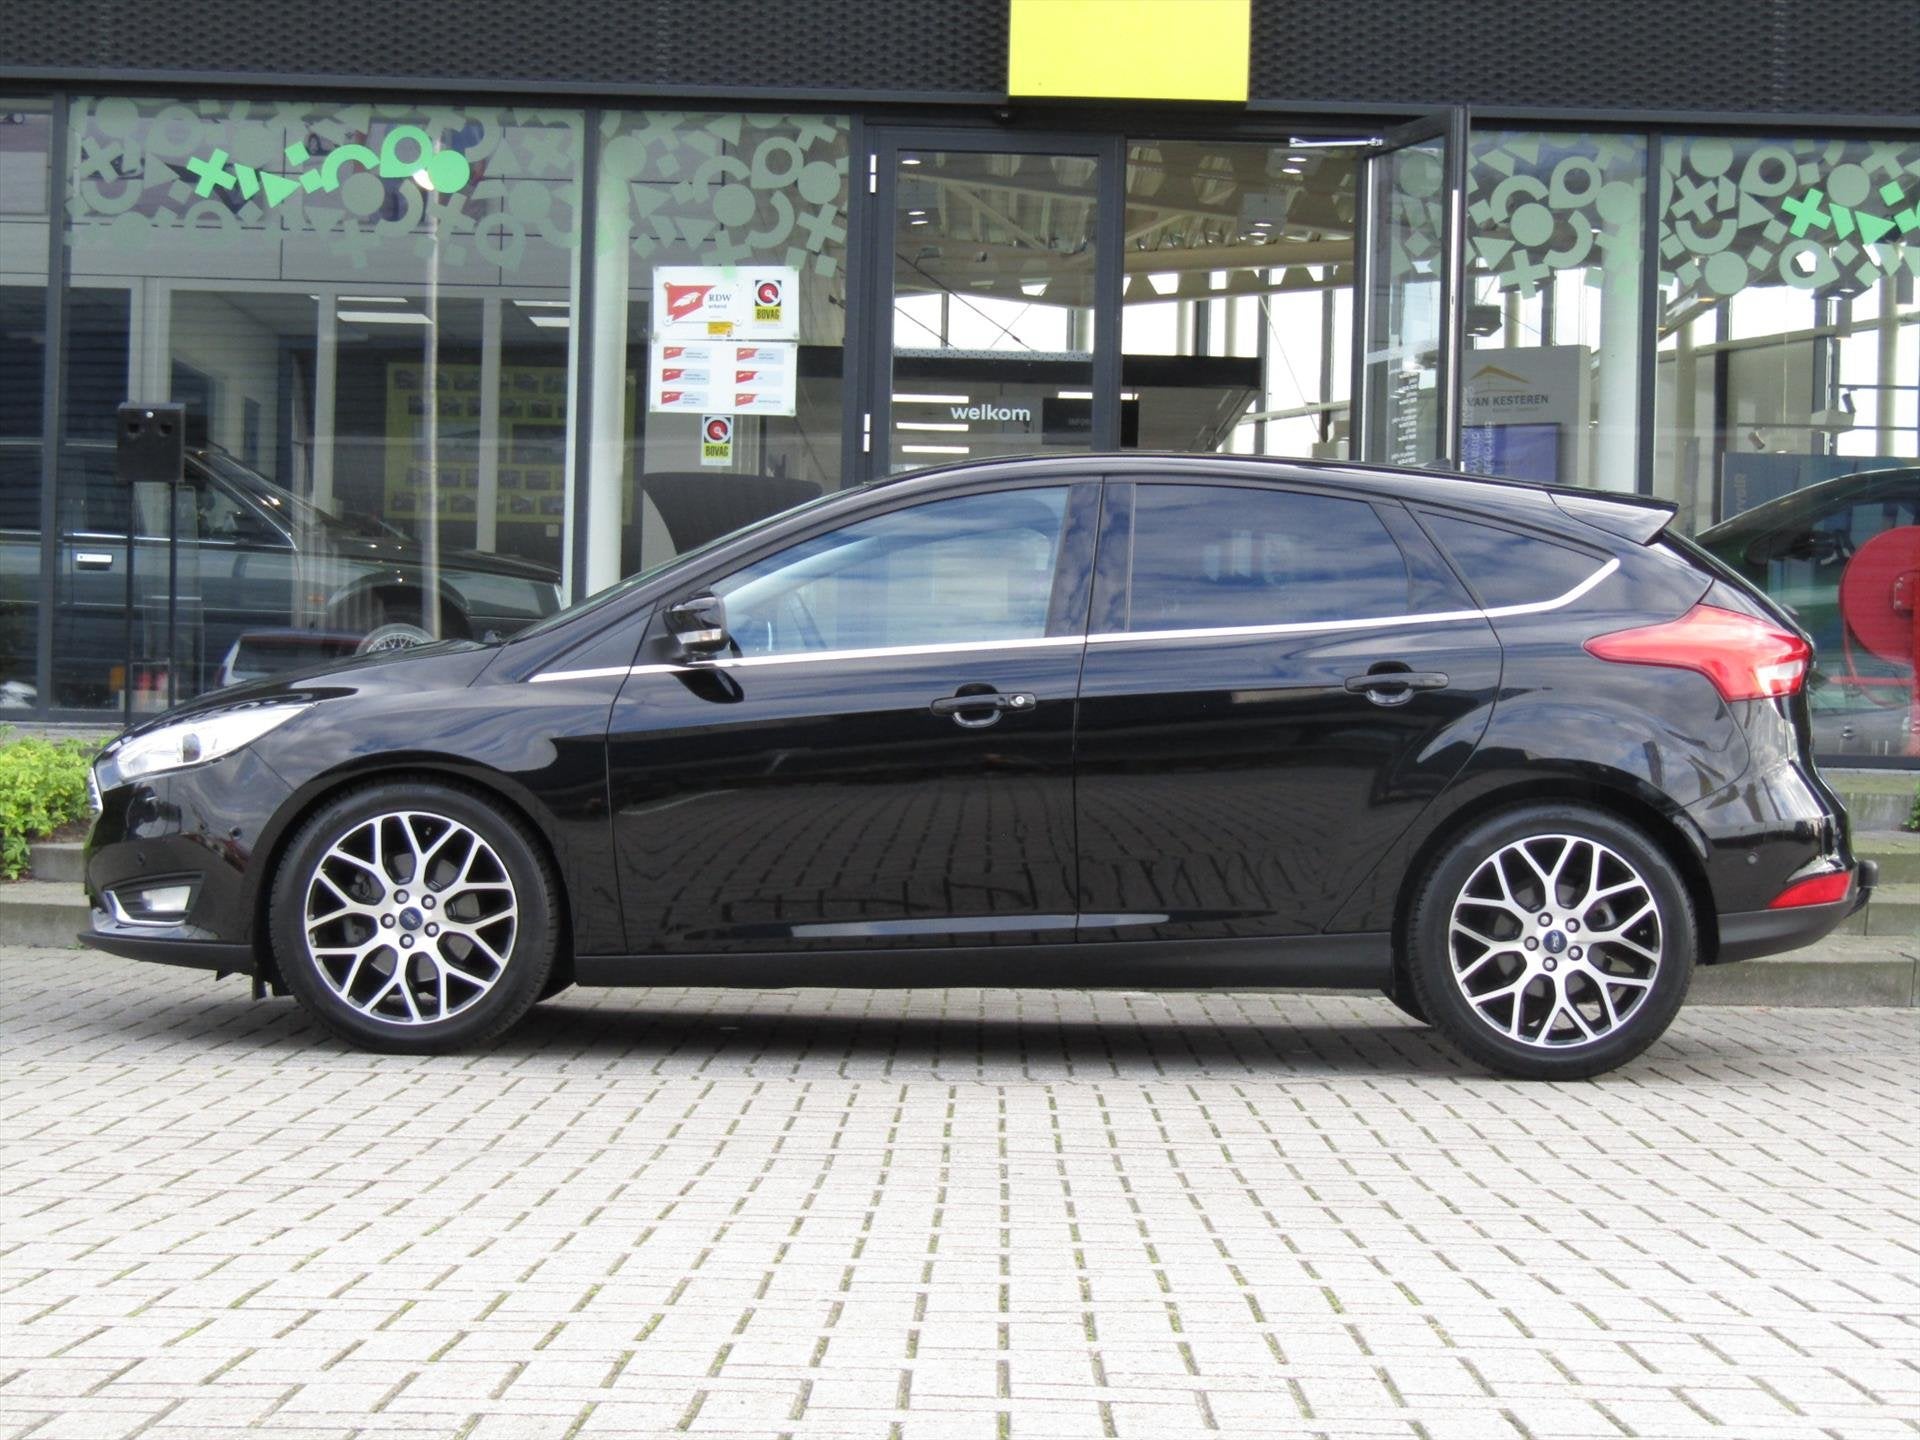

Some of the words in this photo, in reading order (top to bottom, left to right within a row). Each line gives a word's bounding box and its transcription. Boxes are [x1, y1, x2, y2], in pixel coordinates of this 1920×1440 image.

[708, 293, 732, 302] RDW
[756, 309, 780, 320] BOVAG
[1467, 397, 1489, 407] VAN
[1492, 394, 1549, 406] KESTEREN
[950, 404, 1031, 421] welkom
[705, 445, 729, 457] BOVAG
